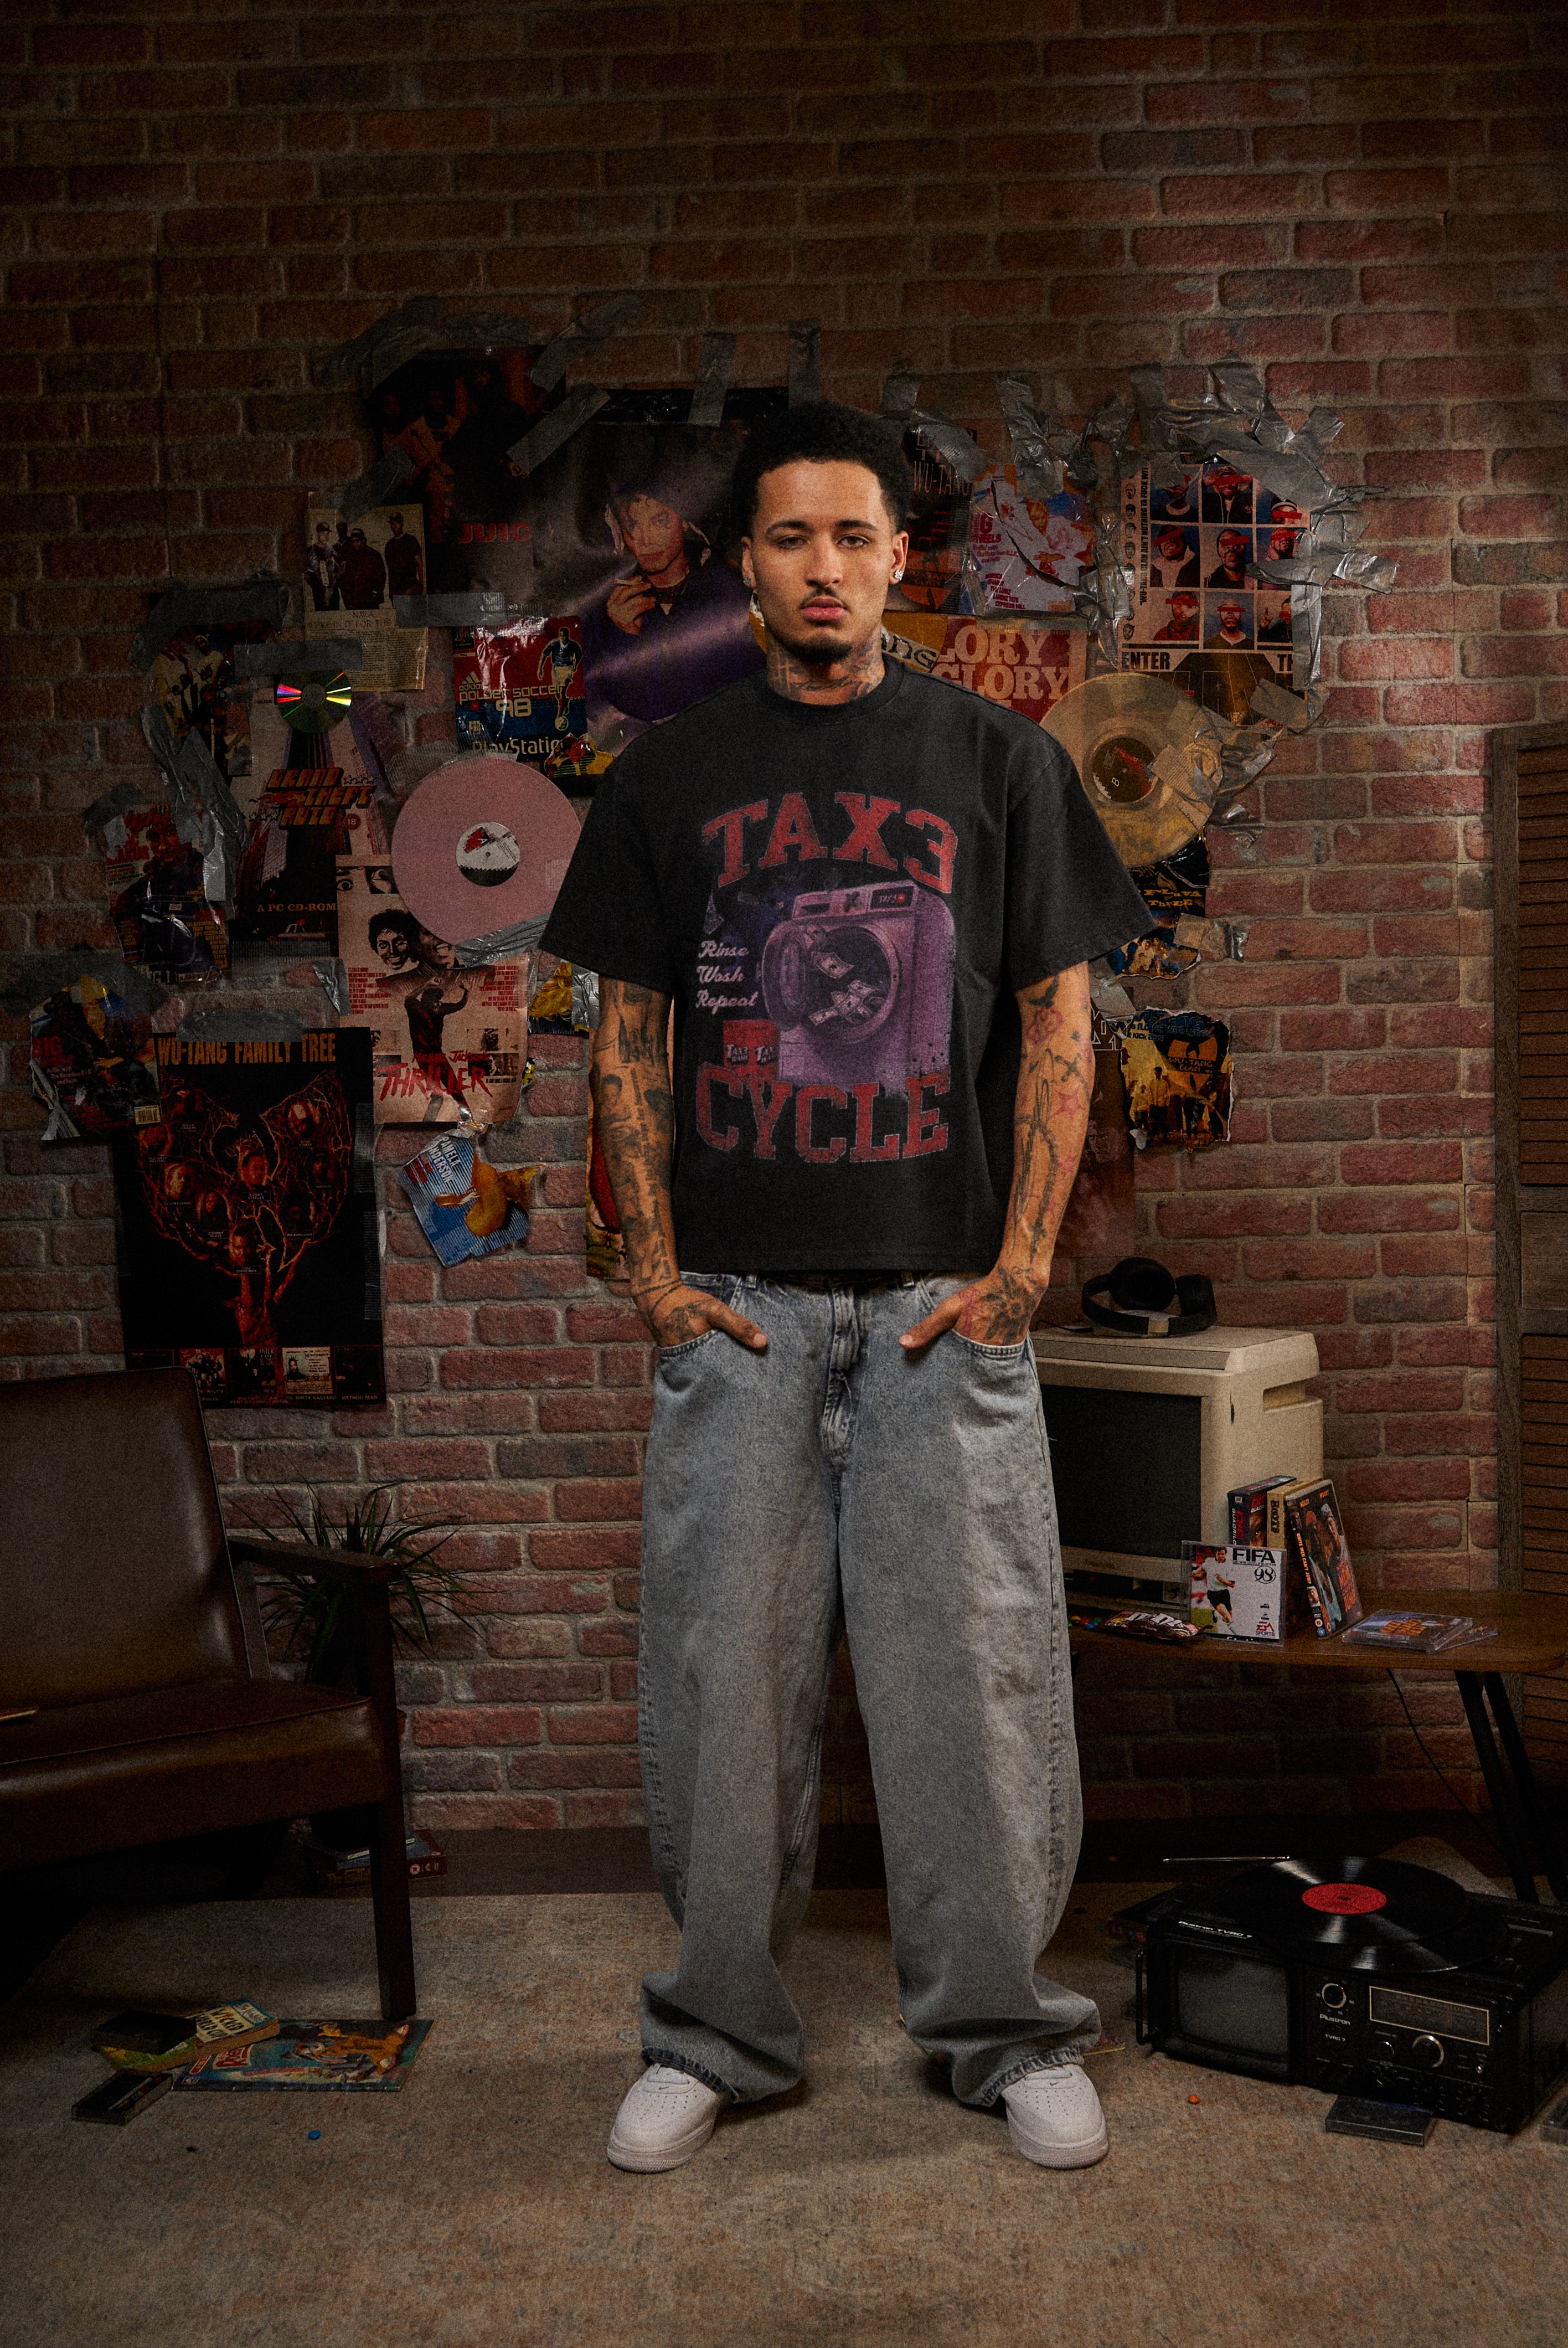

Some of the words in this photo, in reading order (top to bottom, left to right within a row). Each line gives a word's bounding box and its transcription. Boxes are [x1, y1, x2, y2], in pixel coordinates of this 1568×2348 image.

[458, 522, 533, 543] JUIC
[355, 619, 372, 627] FOR
[375, 619, 391, 627] THE
[1121, 652, 1170, 671] ENTER
[459, 682, 485, 692] adidas
[459, 687, 509, 706] power
[512, 684, 564, 698] soccer
[496, 698, 532, 718] 98
[472, 737, 564, 755] PlayStatio
[267, 768, 342, 789] GRAND
[1111, 777, 1120, 787] B
[304, 786, 373, 807] THEFT
[281, 806, 337, 827] AUTO
[347, 817, 357, 826] 18
[702, 792, 958, 893] TAX3
[267, 904, 283, 912] PC
[287, 903, 336, 912] CD-ROM
[698, 940, 750, 959] Rinse
[696, 965, 745, 984] Wash
[695, 990, 759, 1015] Repeat
[157, 1037, 228, 1066] WU-TANG
[234, 1041, 291, 1063] FAMILY
[301, 1033, 337, 1062] TREE
[1168, 1057, 1213, 1067] WU-TANG
[1179, 1064, 1201, 1072] CLAN
[376, 1061, 493, 1101] THRILLER
[697, 1062, 951, 1163] CYCLE
[440, 1136, 461, 1168] PAMELA
[429, 1146, 454, 1183] NDERSON
[1232, 1548, 1275, 1563] FIFA
[1254, 1568, 1274, 1582] 98
[1256, 1621, 1275, 1632] EA
[1319, 2013, 1351, 2026] Plustron
[1324, 2033, 1341, 2042] TVRC
